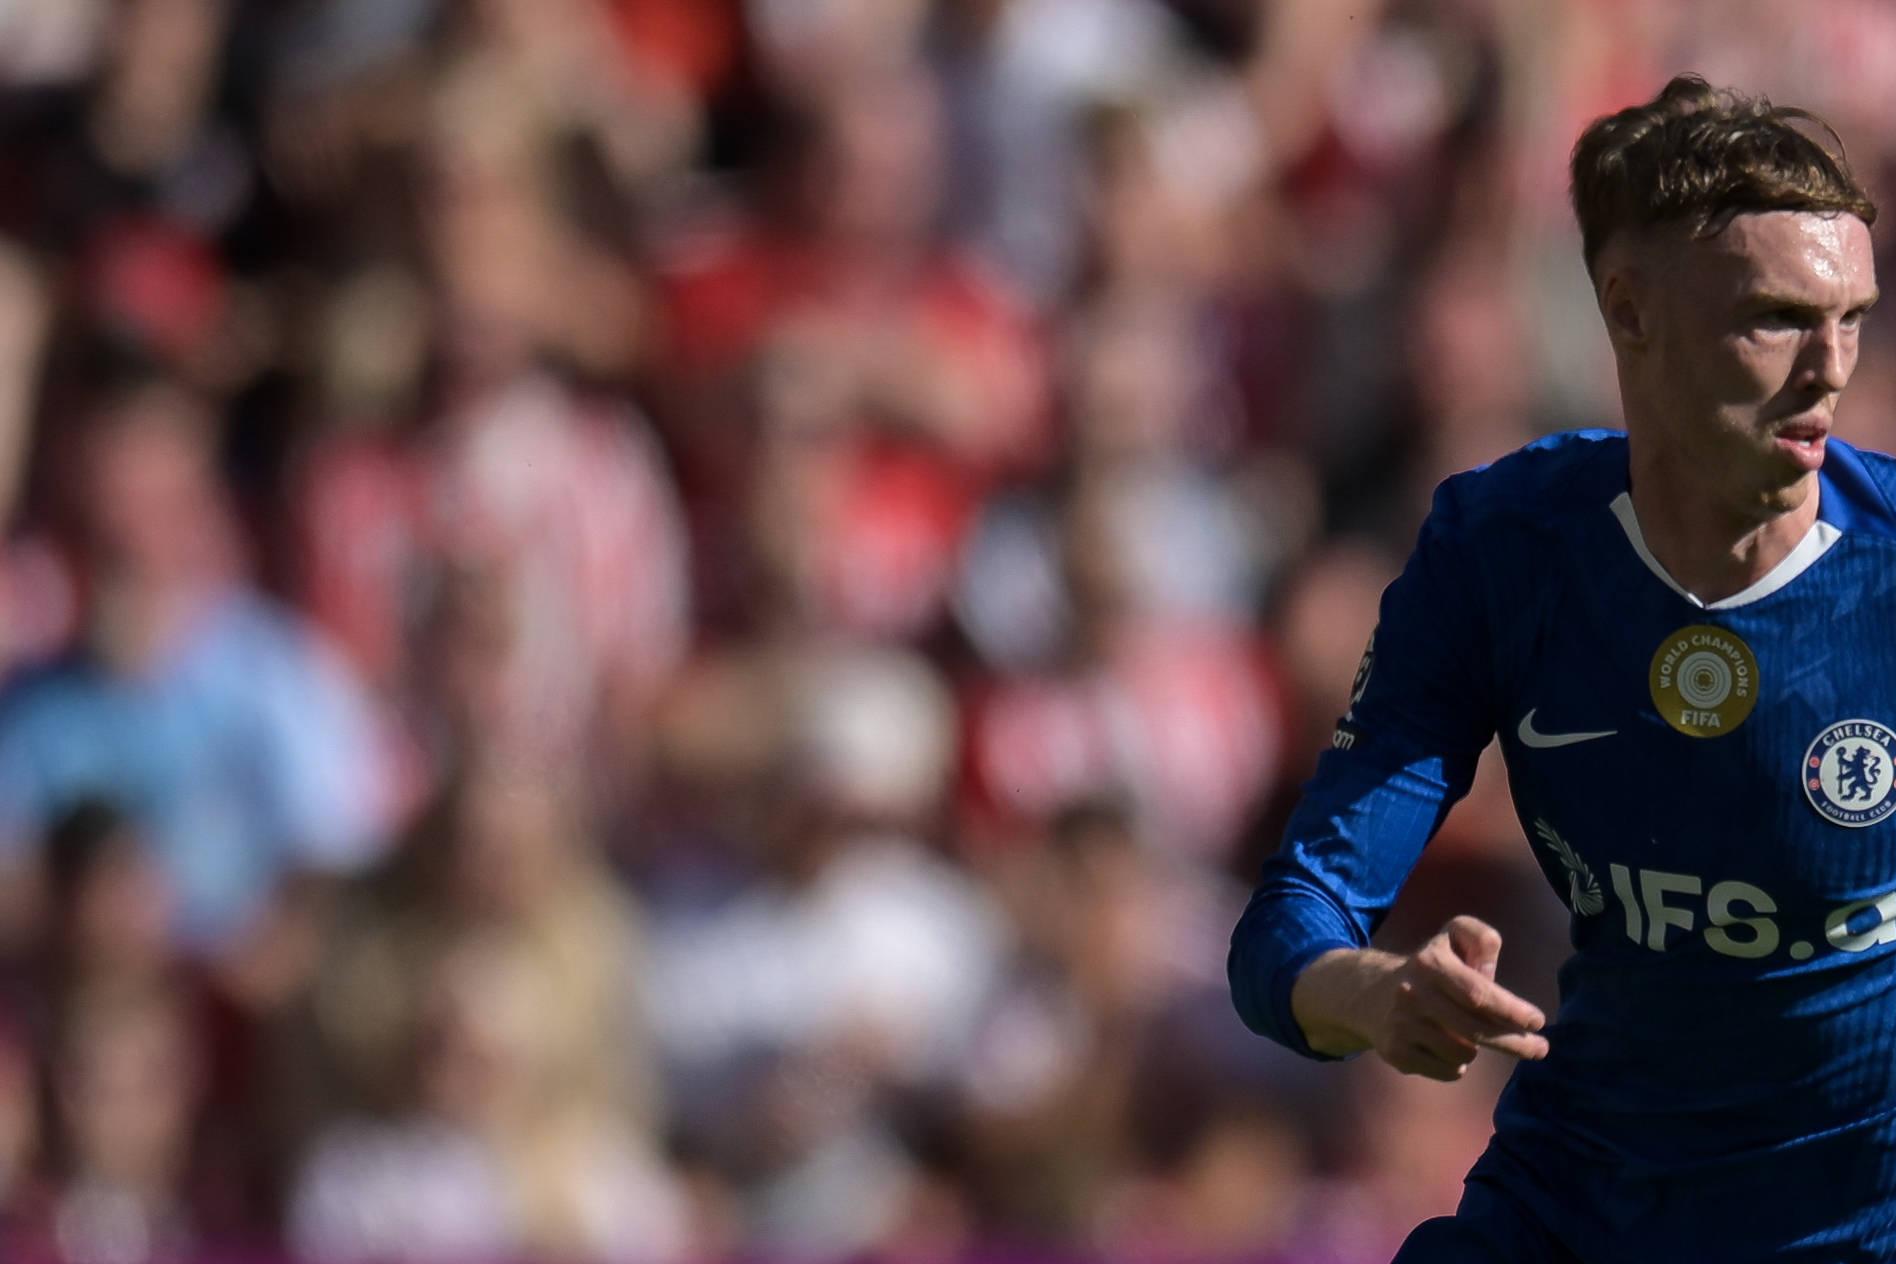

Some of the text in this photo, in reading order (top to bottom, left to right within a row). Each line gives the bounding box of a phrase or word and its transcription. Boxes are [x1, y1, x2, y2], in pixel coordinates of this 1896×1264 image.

[1660, 634, 1749, 698] WORLD CHAMPIONS
[1679, 709, 1721, 728] FIFA
[1822, 724, 1892, 747] CHELSEA
[1820, 800, 1892, 822] FOOTBALL CLUB
